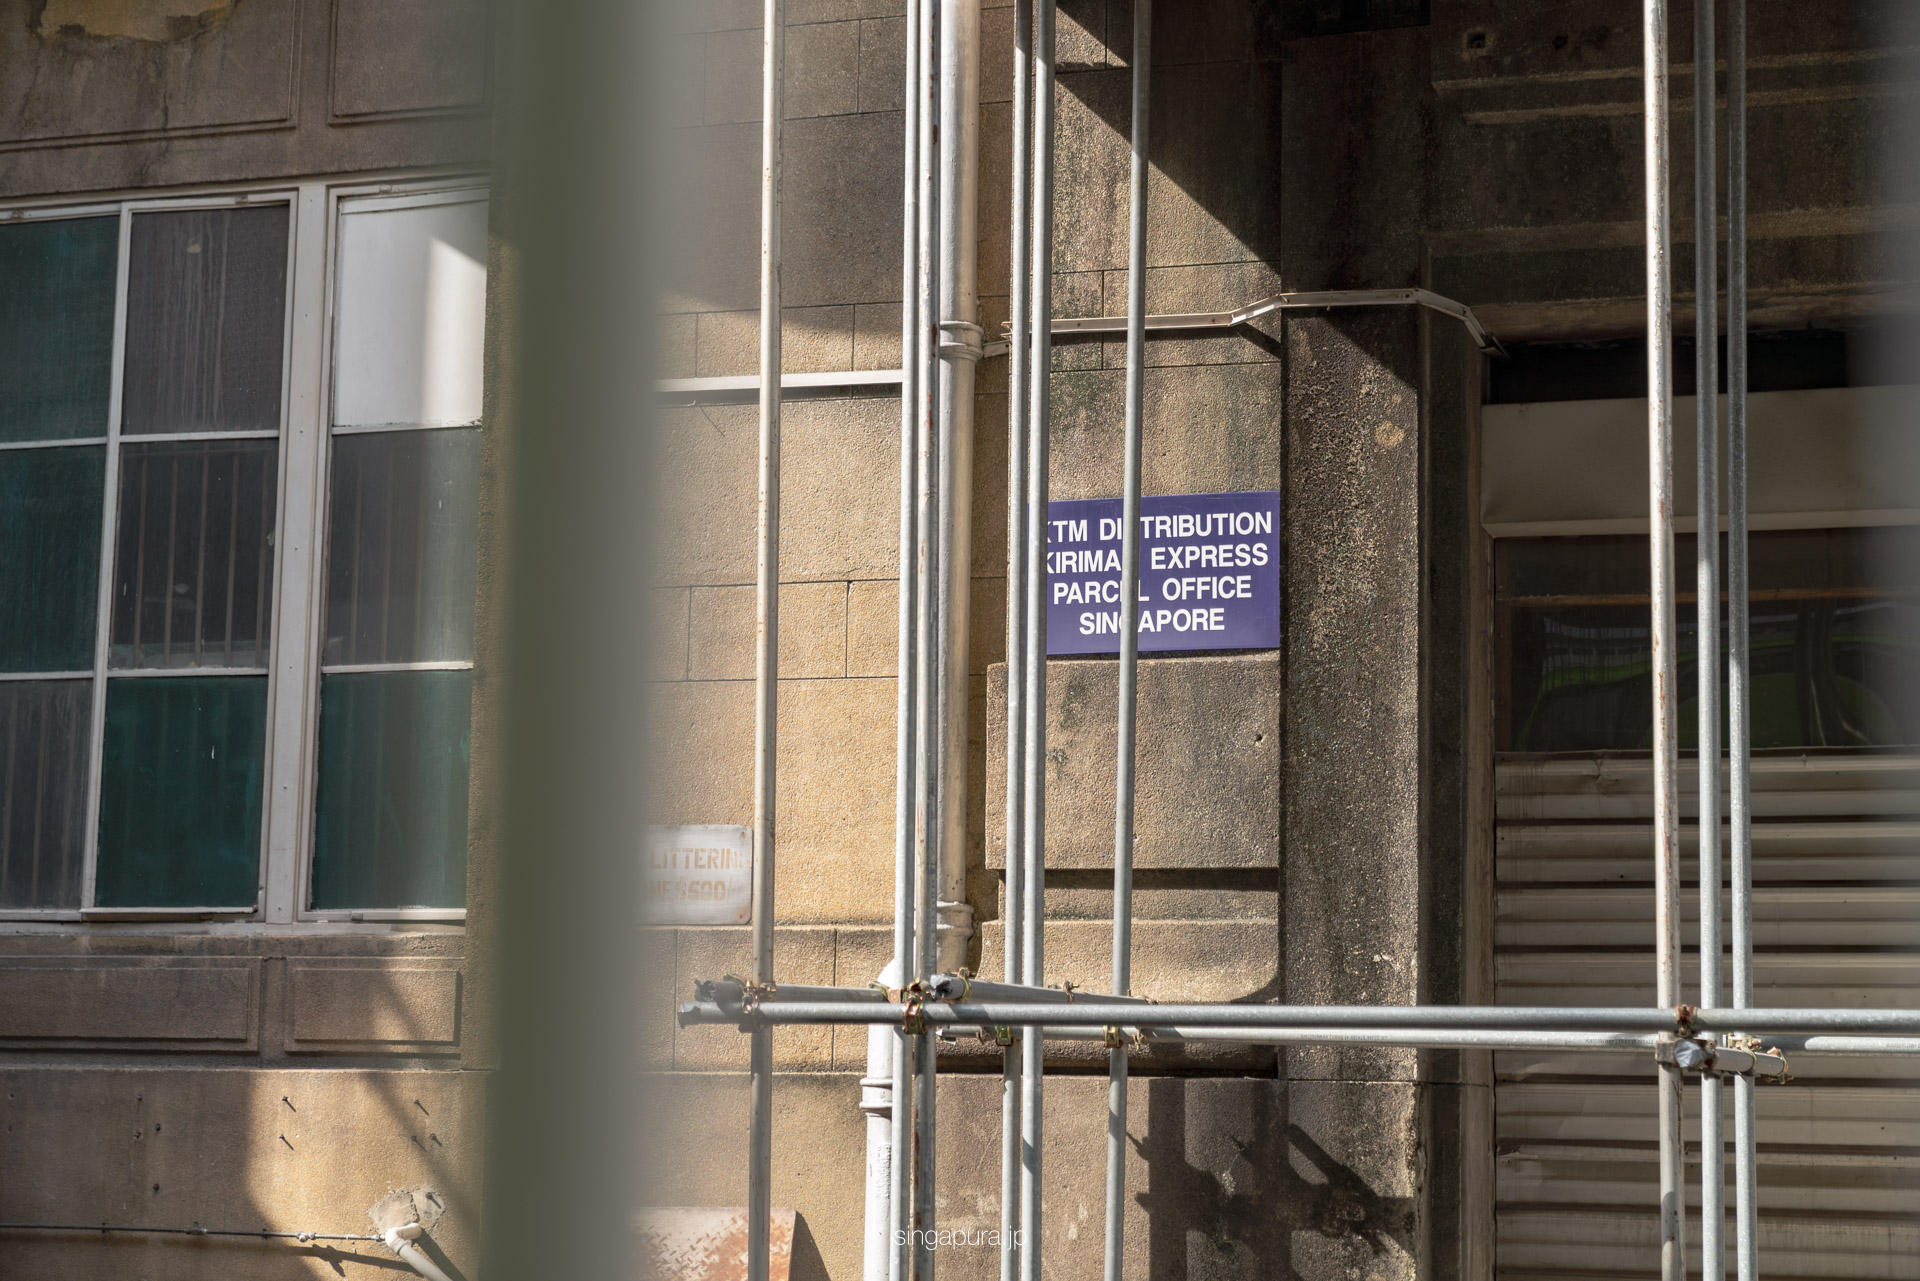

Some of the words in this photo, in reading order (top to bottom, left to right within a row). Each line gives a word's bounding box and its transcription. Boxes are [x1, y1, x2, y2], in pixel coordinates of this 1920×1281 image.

[1100, 511, 1272, 541] DITRIBUTION
[1047, 549, 1122, 574] IRIMA
[1151, 543, 1269, 570] EXPRESS
[1053, 579, 1150, 605] PARCL
[1162, 575, 1252, 601] OFFICE
[1079, 608, 1225, 635] SINAPORE
